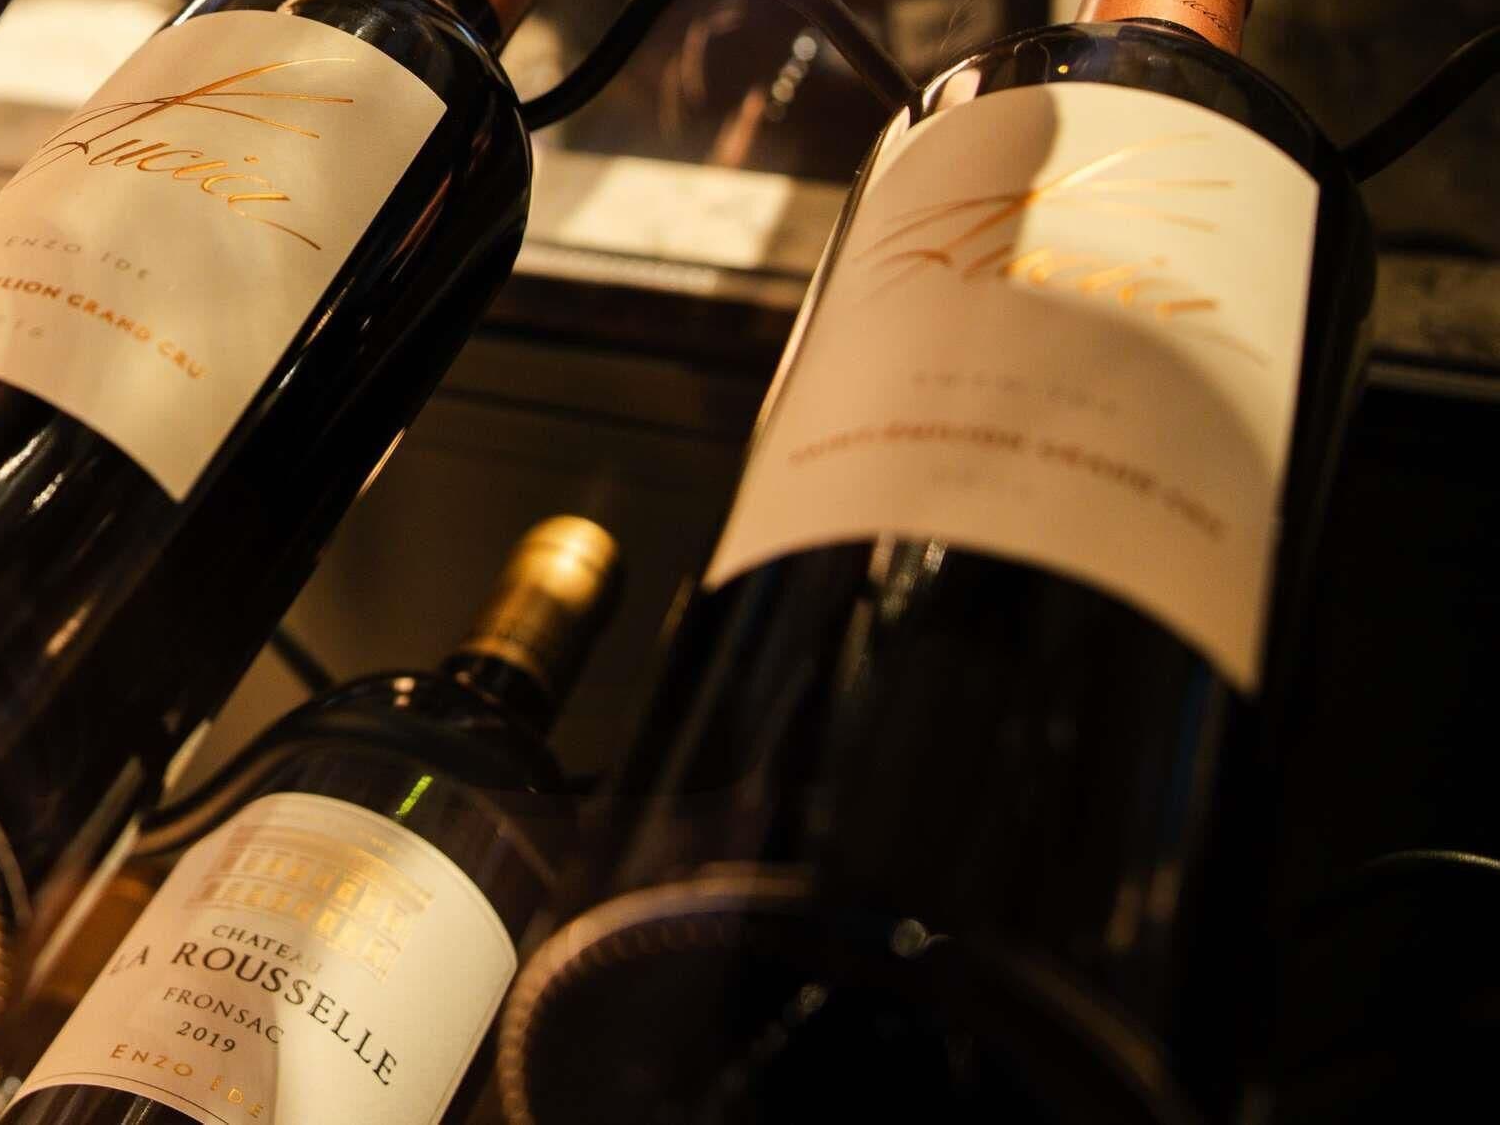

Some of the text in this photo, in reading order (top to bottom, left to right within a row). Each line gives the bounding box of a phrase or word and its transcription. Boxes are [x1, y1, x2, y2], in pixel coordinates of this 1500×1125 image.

[12, 57, 356, 251] Lucia
[67, 292, 152, 342] GRAND
[158, 342, 206, 379] CRU
[162, 986, 285, 1044] FRONSAC
[171, 941, 398, 1087] ROUSSELLE
[175, 1021, 237, 1053] 2019
[108, 1043, 194, 1078] ENZO
